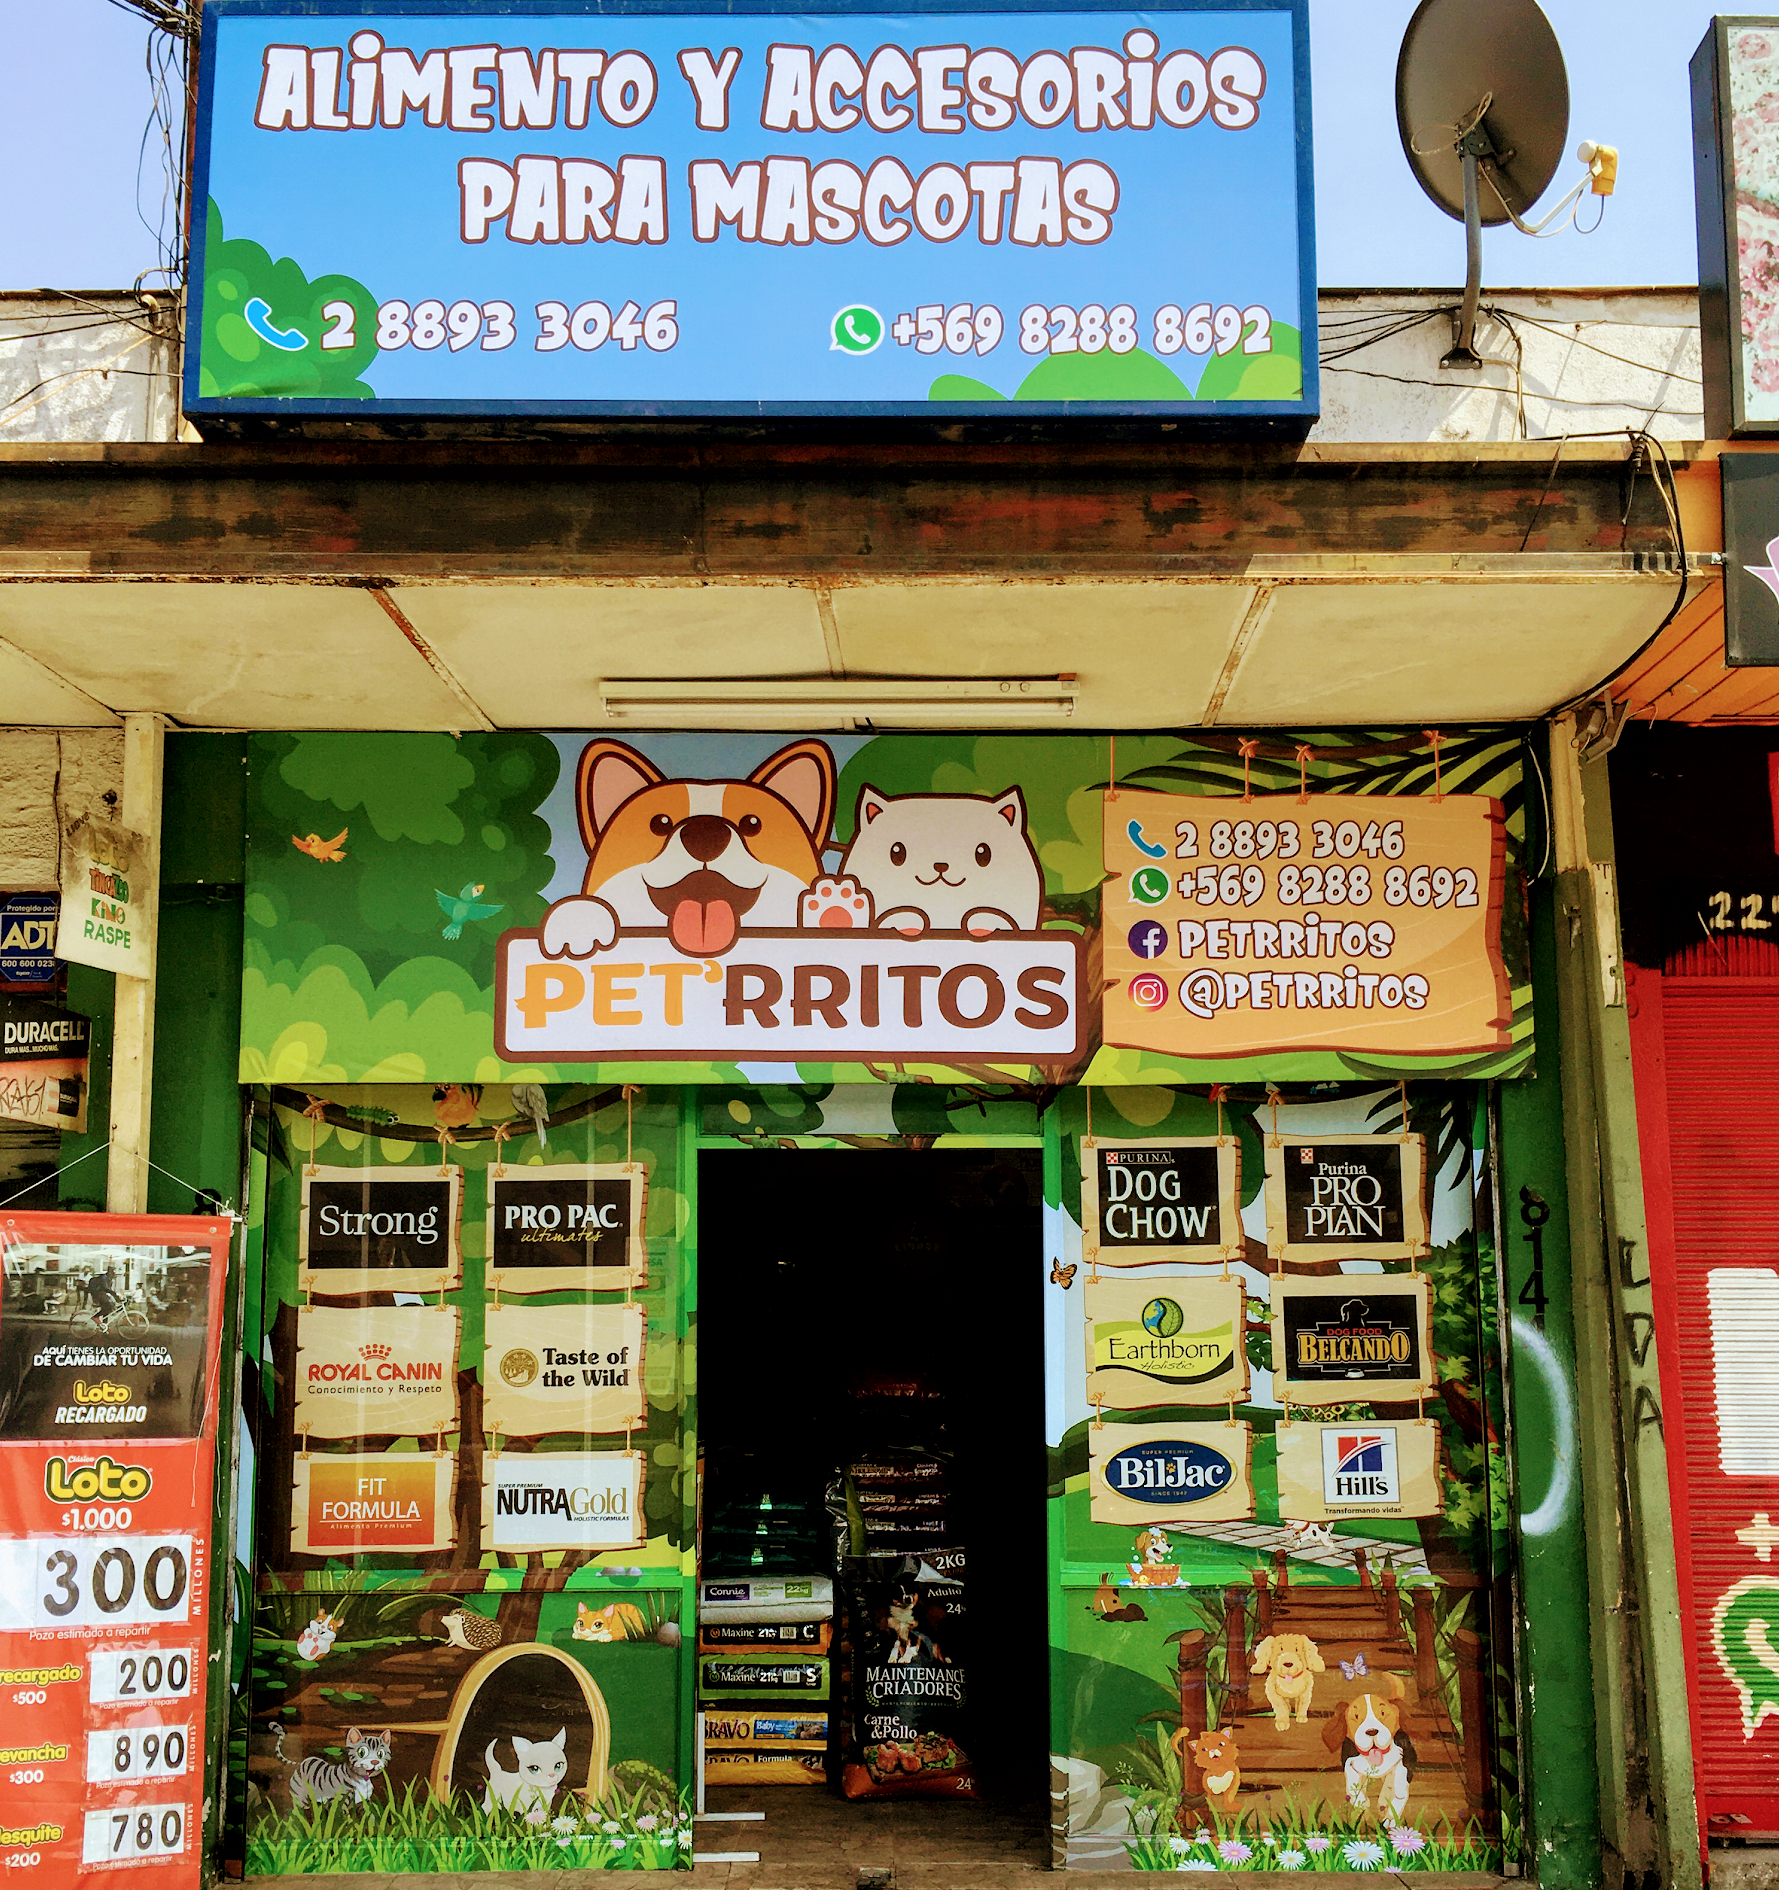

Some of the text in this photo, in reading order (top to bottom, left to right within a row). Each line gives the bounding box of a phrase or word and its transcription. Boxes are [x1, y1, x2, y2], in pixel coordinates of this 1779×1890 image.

[677, 47, 743, 132] Y
[457, 154, 1120, 246] PARA MASCOTAS
[320, 299, 679, 352] 2 8893 3046
[892, 303, 1273, 357] +569 8288 8692
[1175, 820, 1405, 859] 2 8893 3046
[1177, 864, 1479, 908] +569 8288 8692
[7, 905, 41, 913] Protegido
[1, 921, 58, 950] ADT
[84, 920, 130, 949] RASPE
[2, 960, 17, 968] 600
[19, 960, 35, 968] 600
[4, 1021, 85, 1043] DURACELL
[1119, 1152, 1169, 1164] PURINA
[1318, 1162, 1367, 1176] Purina
[1108, 1166, 1181, 1201] DOG
[1310, 1175, 1382, 1207] PRO
[319, 1205, 438, 1244] Strong
[504, 1204, 617, 1229] PRO PAC
[1105, 1204, 1211, 1239] CHOW
[1303, 1205, 1386, 1237] PLAN
[521, 1226, 603, 1243] ultimates
[1327, 1327, 1382, 1336] DOG FOOD
[67, 1347, 94, 1355] TIENES
[95, 1347, 106, 1355] LA
[107, 1347, 167, 1355] OPORTUNIDAD
[543, 1347, 628, 1365] Taste of
[1109, 1338, 1220, 1361] Earthborn
[1297, 1330, 1410, 1364] BELCANDO
[34, 1354, 173, 1367] DE CAMBIAR TU VIDA
[1140, 1361, 1194, 1371] Holistic
[308, 1362, 442, 1382] ROYAL CANIN
[543, 1368, 629, 1387] the Wild
[75, 1381, 131, 1405] Loto
[308, 1384, 442, 1396] Conocimiento y Respeto
[54, 1406, 147, 1424] RECARGADO
[47, 1457, 151, 1502] Loto
[358, 1478, 387, 1496] FIT
[1336, 1475, 1388, 1496] Hill's
[61, 1508, 132, 1530] $1.000
[322, 1501, 420, 1520] FORMULA
[43, 1545, 187, 1617] 300
[191, 1538, 204, 1616] MILLONES
[710, 1587, 746, 1596] Connie
[29, 1630, 54, 1641] Pozo
[56, 1628, 103, 1639] estimado
[115, 1626, 151, 1637] repartir
[721, 1628, 755, 1638] Maxine
[803, 1625, 814, 1638] C
[119, 1654, 188, 1695] 200
[721, 1671, 755, 1682] Maxine
[806, 1668, 816, 1682] S
[866, 1666, 966, 1683] MAINTENANCE
[12, 1690, 46, 1705] $500
[873, 1681, 961, 1700] CRIADORES
[154, 1698, 178, 1706] repartir
[756, 1720, 775, 1731] Baby
[864, 1714, 900, 1726] Carne
[871, 1725, 917, 1739] &Pollo
[114, 1731, 185, 1773] 890
[189, 1725, 197, 1772] MILLONES
[9, 1770, 44, 1784] $300
[113, 1779, 143, 1787] estimado
[113, 1810, 181, 1852] 780
[186, 1803, 194, 1850] MILLONES
[5, 1852, 40, 1867] $200
